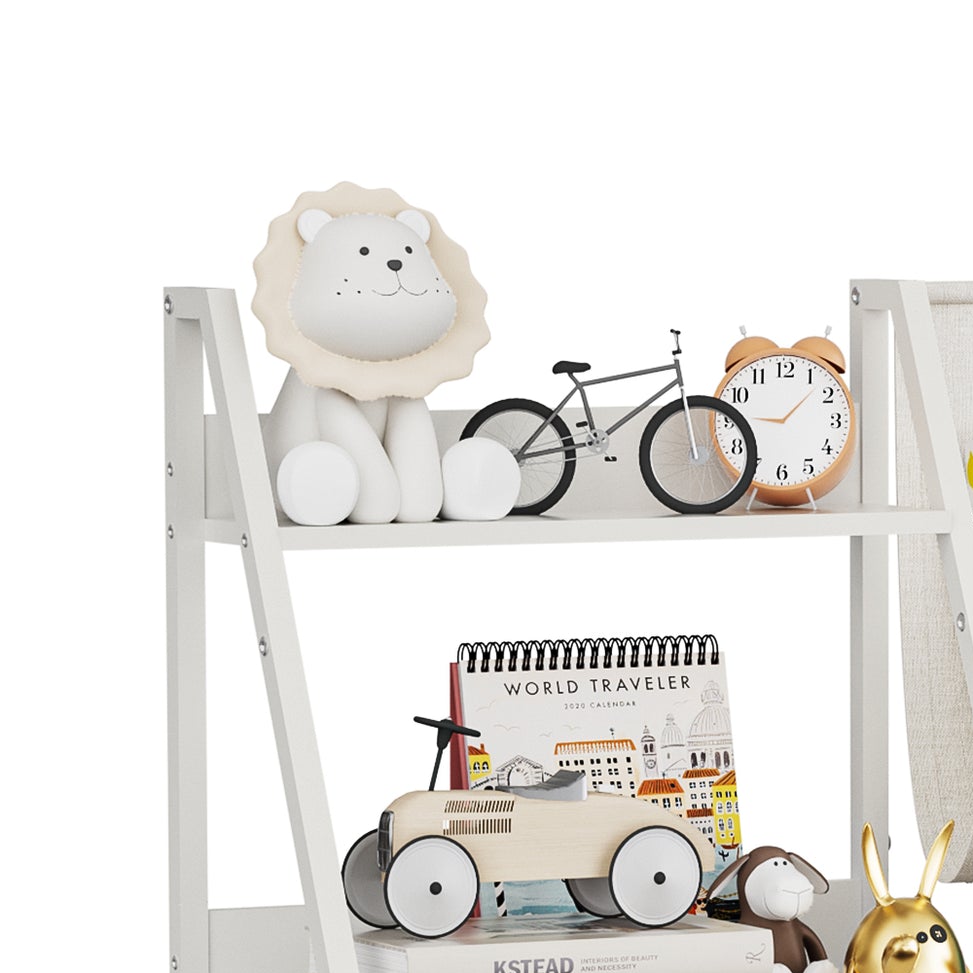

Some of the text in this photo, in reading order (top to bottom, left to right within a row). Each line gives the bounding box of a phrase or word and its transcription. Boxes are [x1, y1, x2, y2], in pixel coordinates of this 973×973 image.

[752, 368, 765, 385] 11
[776, 361, 795, 379] 12
[807, 368, 813, 385] 1
[731, 386, 749, 404] 10
[822, 386, 834, 404] 2
[830, 412, 842, 429] 3
[731, 438, 743, 455] 8
[821, 438, 833, 455] 4
[776, 463, 788, 481] 6
[802, 458, 814, 475] 5
[504, 675, 691, 696] WORLD TRAVELER
[564, 700, 637, 710] 2020 CALENDAR
[580, 957, 619, 965] INTERIORS
[631, 954, 659, 962] BEAUTY
[580, 963, 637, 973] AND NECESSITY
